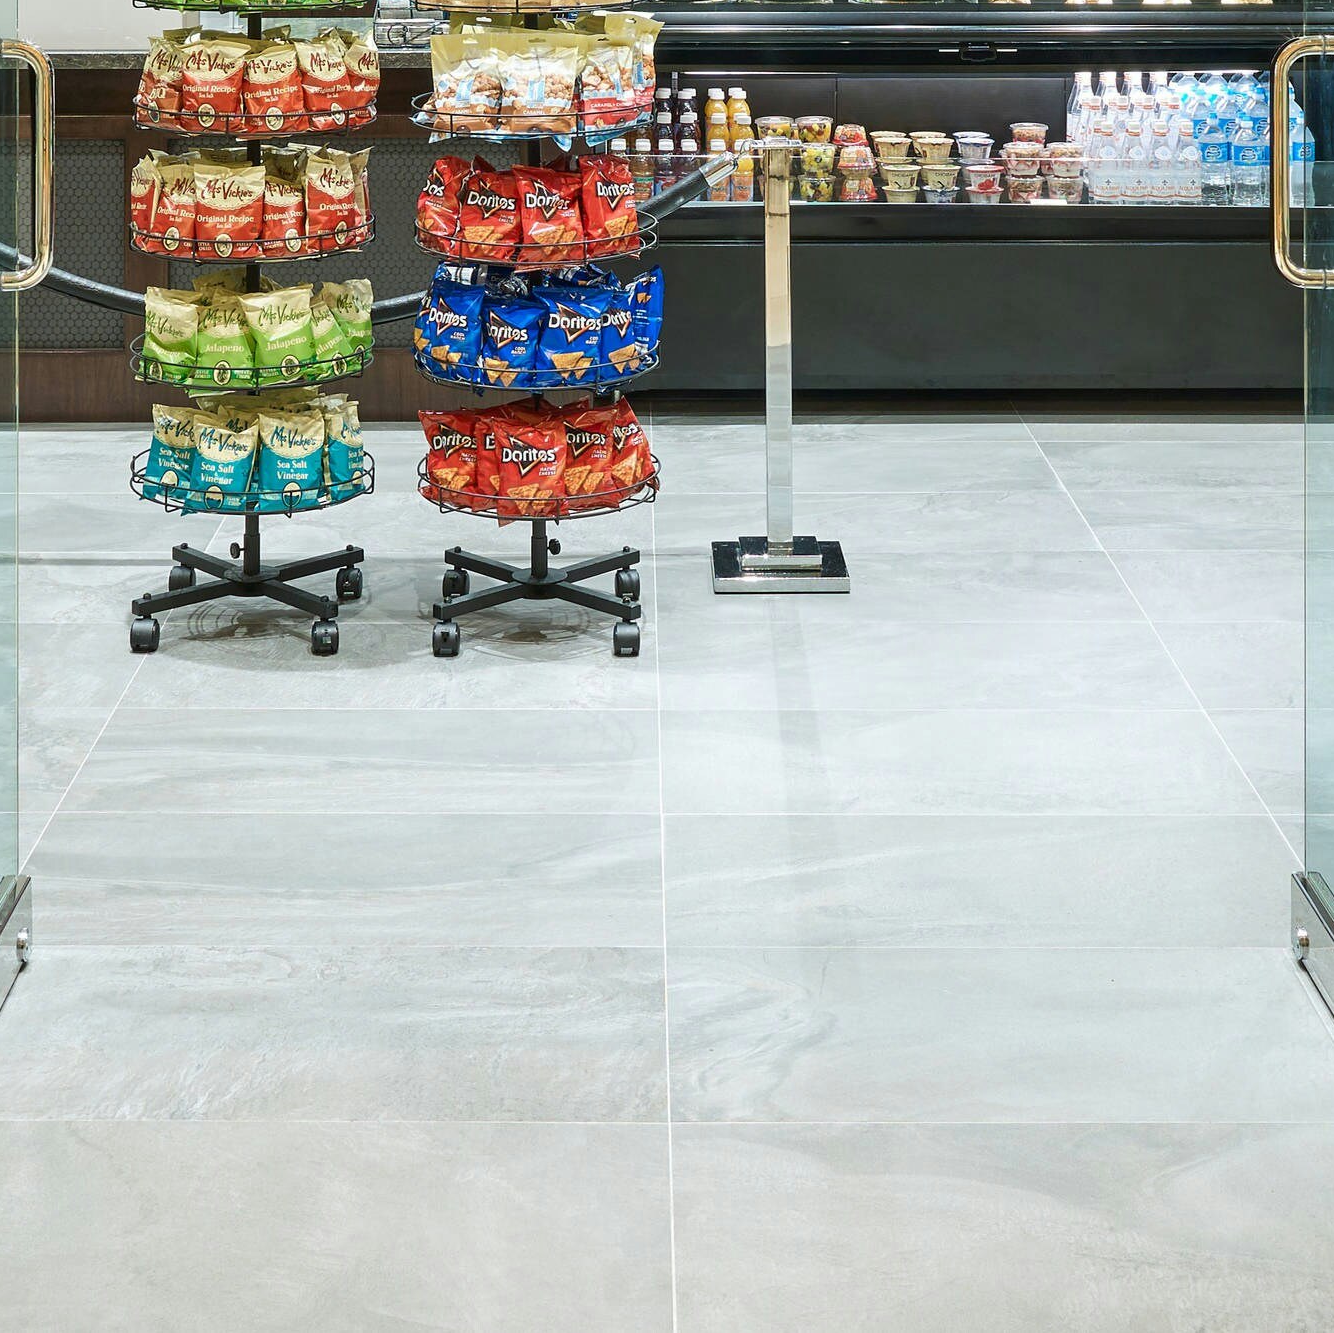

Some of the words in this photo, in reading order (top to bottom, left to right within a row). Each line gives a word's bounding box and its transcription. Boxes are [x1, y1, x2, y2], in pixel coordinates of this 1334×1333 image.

[183, 84, 209, 93] Original
[210, 86, 236, 94] Recipe
[245, 89, 272, 99] Original
[273, 85, 298, 96] Recipe
[597, 181, 635, 197] Doritos
[467, 190, 516, 210] Doritos
[525, 194, 570, 210] Doritos
[197, 214, 228, 223] Original
[229, 215, 254, 224] Recipe
[428, 307, 467, 328] Doritos
[549, 313, 602, 330] Doritos
[567, 432, 606, 446] oritos
[502, 447, 556, 463] Doritos
[201, 461, 215, 471] Sea
[218, 465, 234, 474] Salt
[277, 460, 290, 469] Sea
[292, 460, 308, 469] Salt
[200, 472, 234, 485] Vinegar
[277, 471, 308, 481] Vinegar
